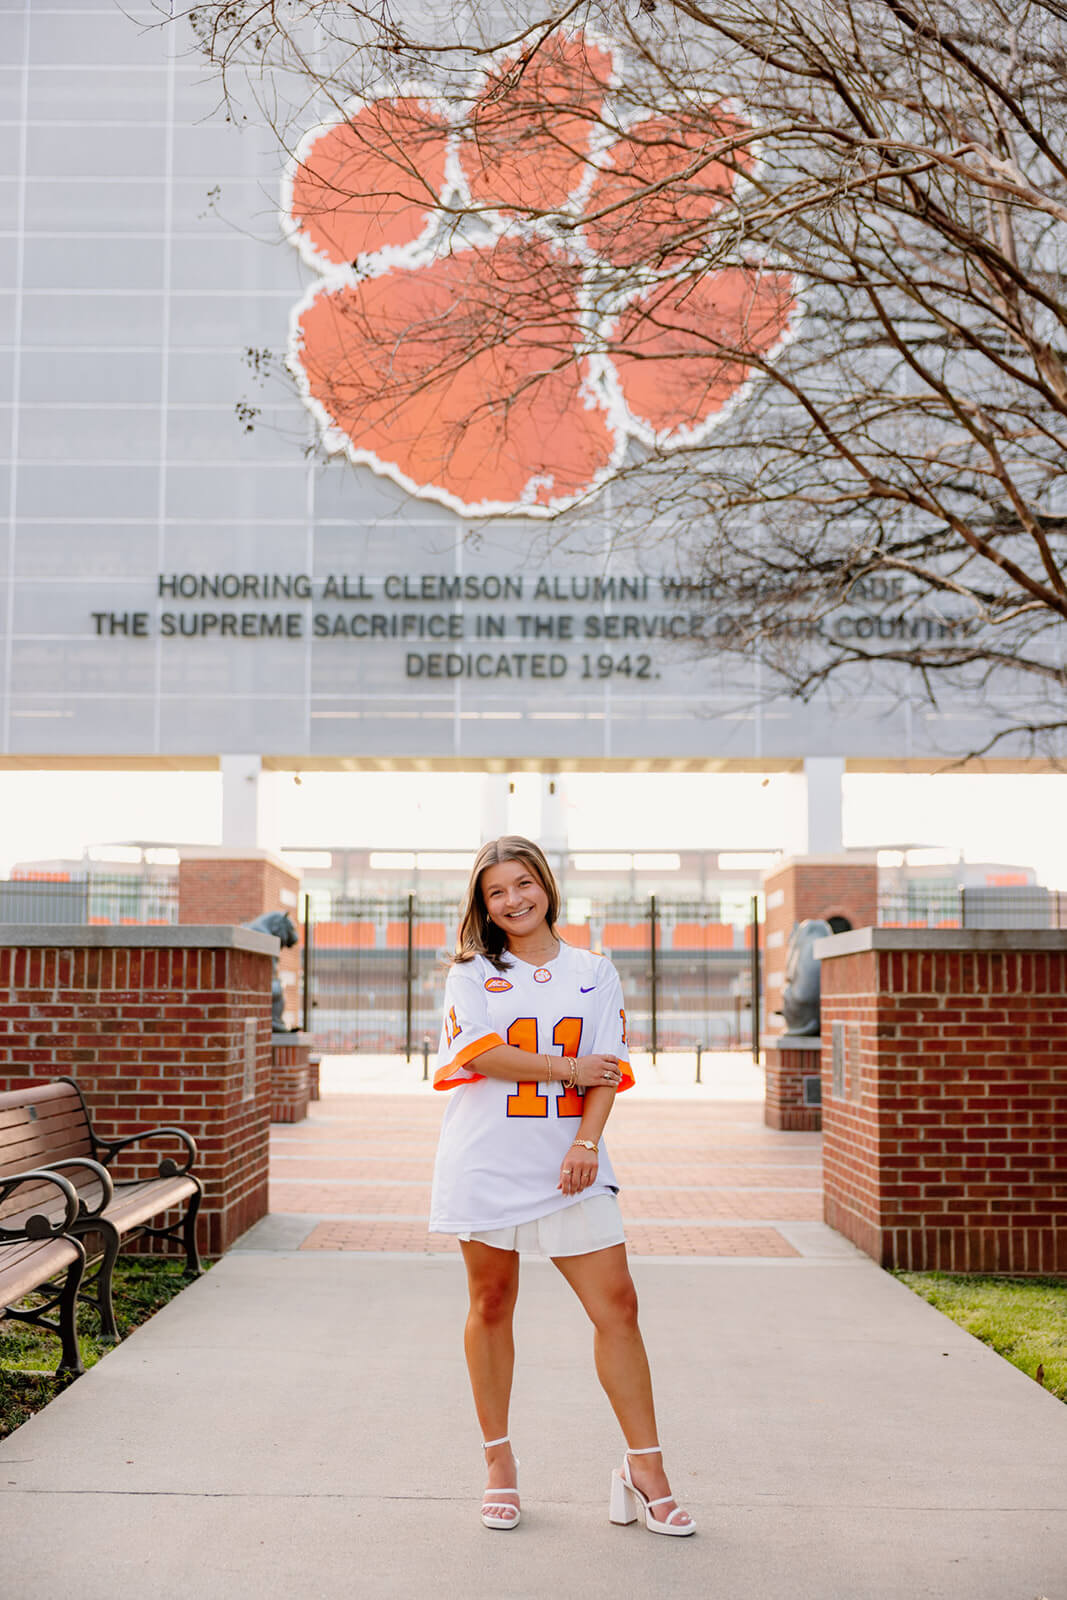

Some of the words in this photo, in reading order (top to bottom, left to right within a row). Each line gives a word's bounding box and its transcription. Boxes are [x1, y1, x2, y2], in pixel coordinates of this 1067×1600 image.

[157, 574, 312, 600] HONORING
[322, 575, 374, 600] ALL
[383, 576, 523, 600] CLEMSON
[533, 576, 649, 601] ALUMNI
[91, 612, 149, 637] THE
[160, 613, 303, 638] SUPREME
[313, 614, 464, 638] SACRIFICE
[476, 615, 504, 638] IN
[516, 615, 573, 639] THE
[584, 615, 705, 640] SERVICE
[406, 653, 568, 678] DEDICATED
[580, 654, 661, 679] 1942.
[506, 1017, 585, 1118] 11
